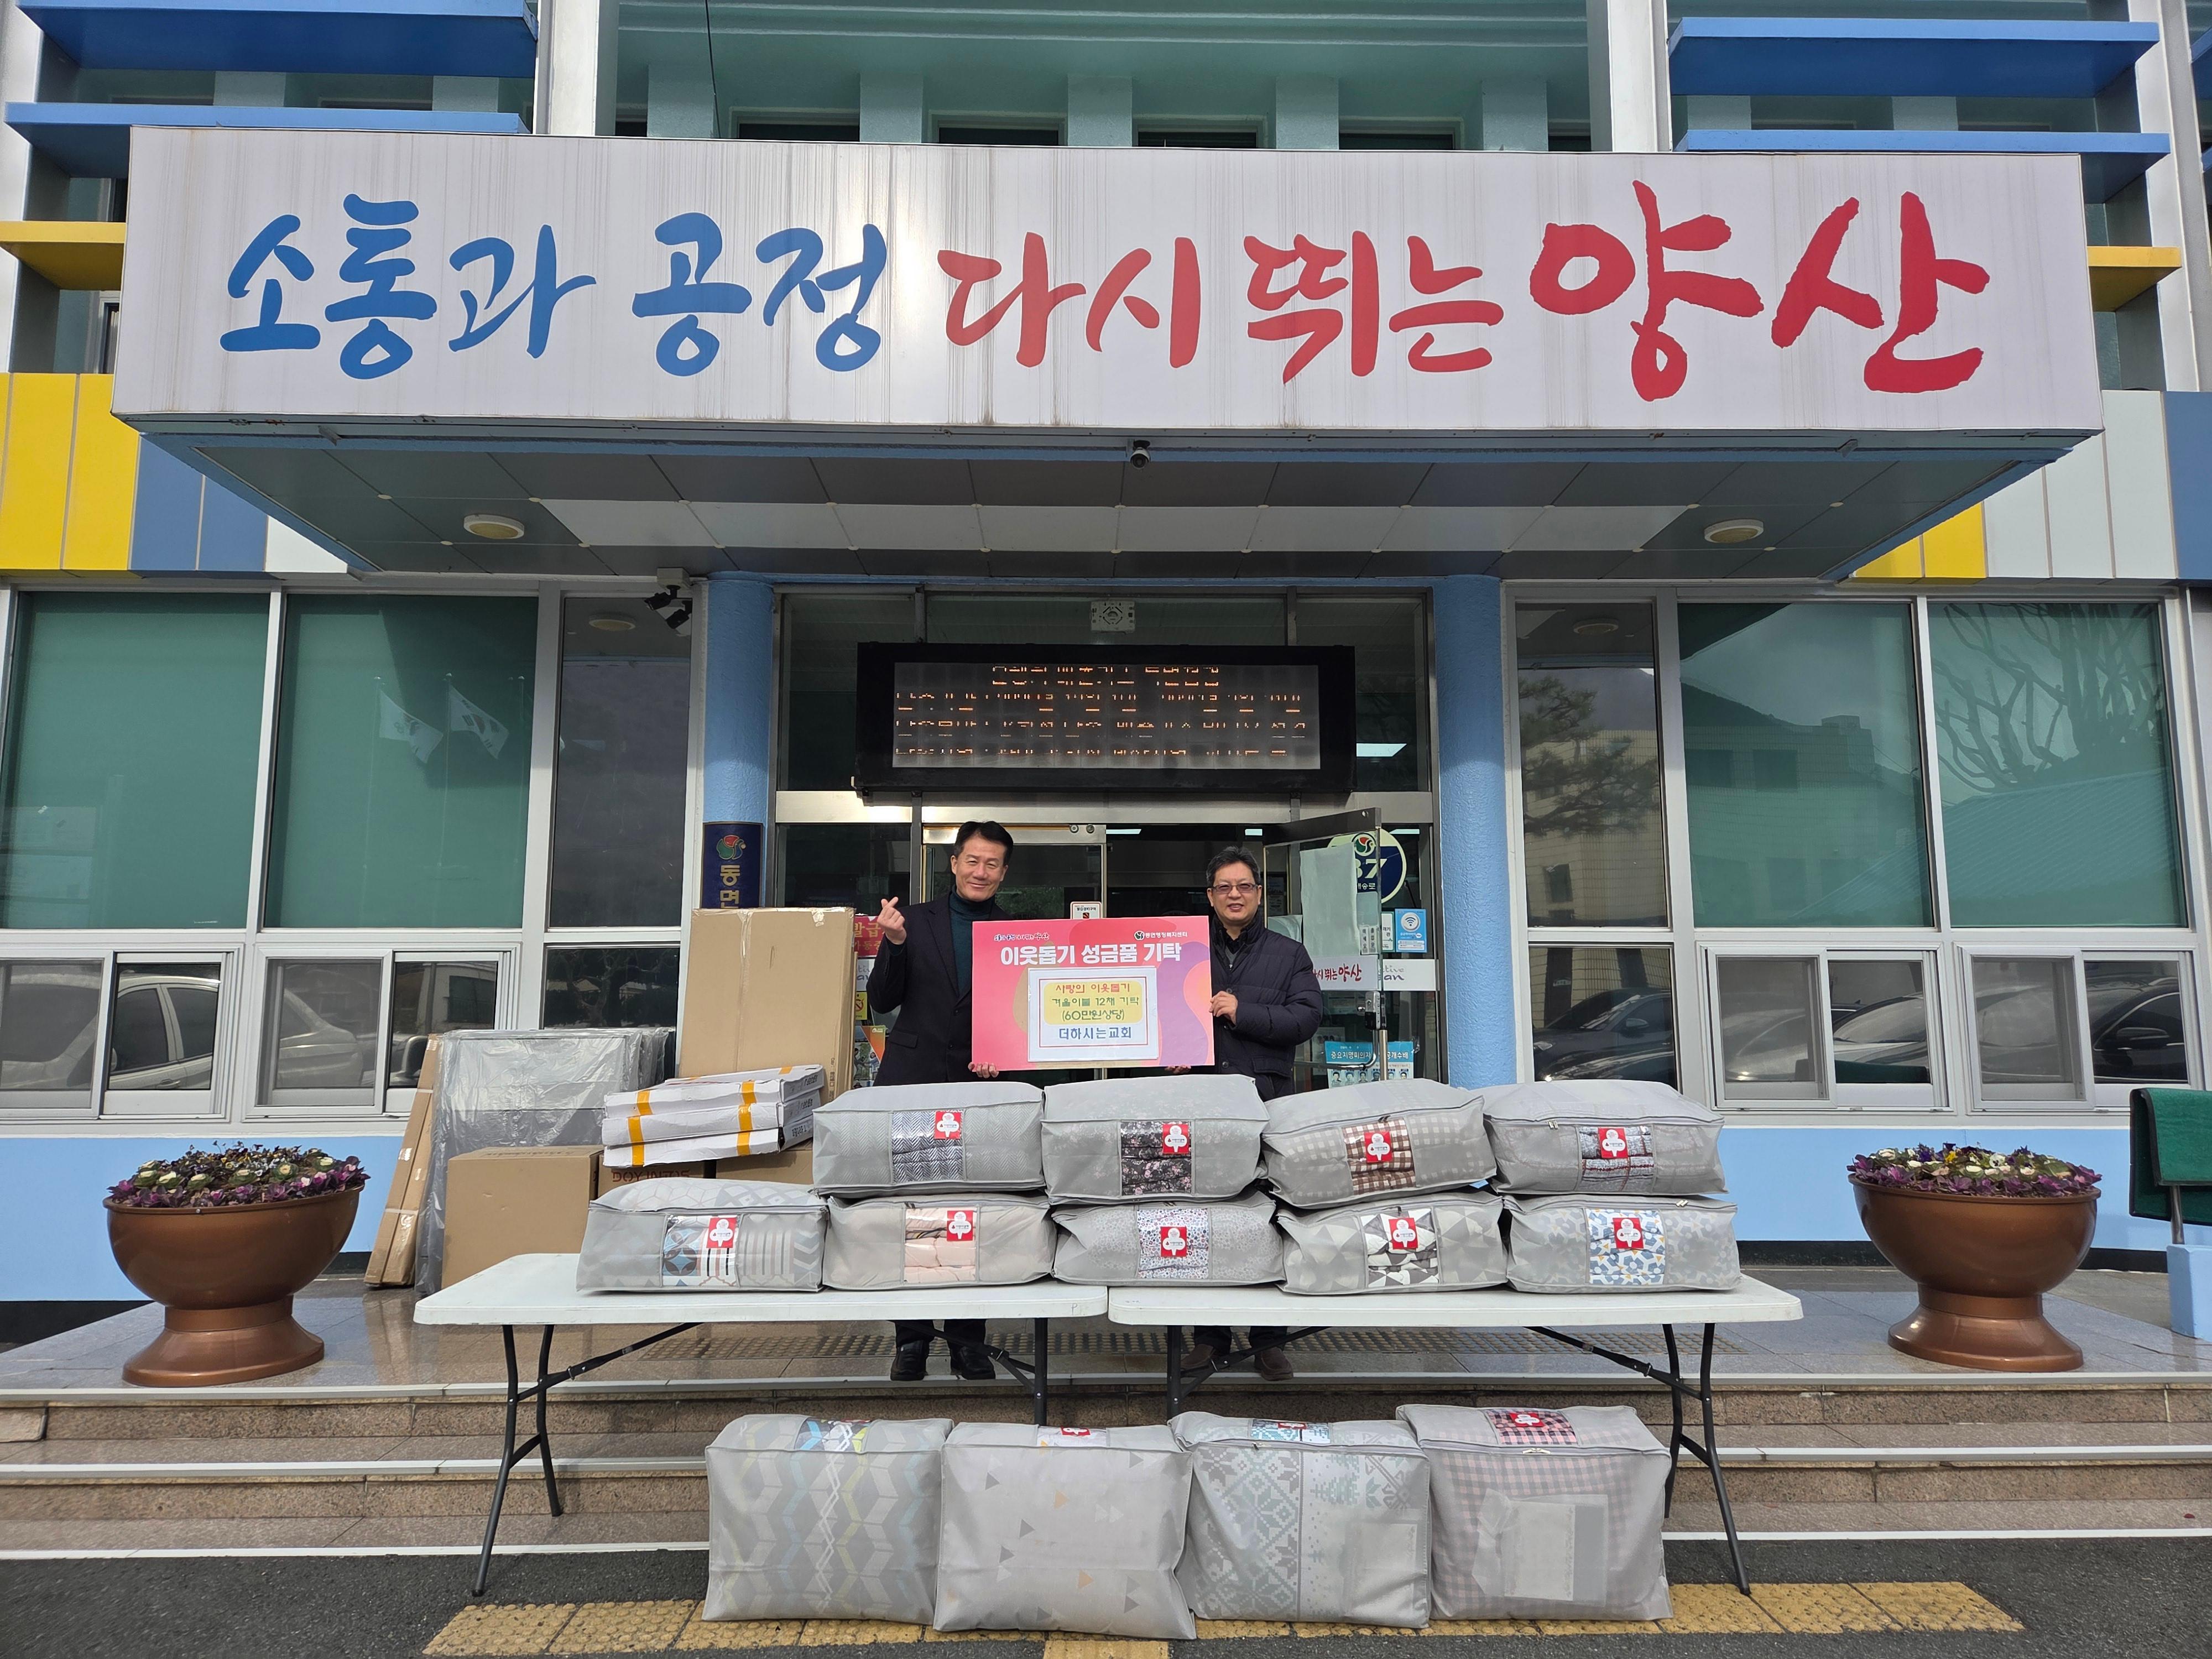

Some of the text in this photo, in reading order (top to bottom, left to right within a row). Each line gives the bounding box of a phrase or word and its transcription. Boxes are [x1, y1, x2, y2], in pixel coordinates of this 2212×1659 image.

[220, 180, 1990, 402] 소통과 공정 다시 뛰는 양산
[720, 865, 740, 909] 동면
[854, 922, 885, 938] 발급
[1001, 943, 1182, 966] 이웃돕기 성금품 기탁
[1339, 963, 1362, 982] 양산
[1056, 983, 1130, 994] 사랑의 이웃돕기
[1052, 997, 1139, 1007] 겨울이불 12채 기탁
[1062, 1009, 1125, 1021] (60만원상당)
[1059, 1027, 1131, 1040] 더하시는교회
